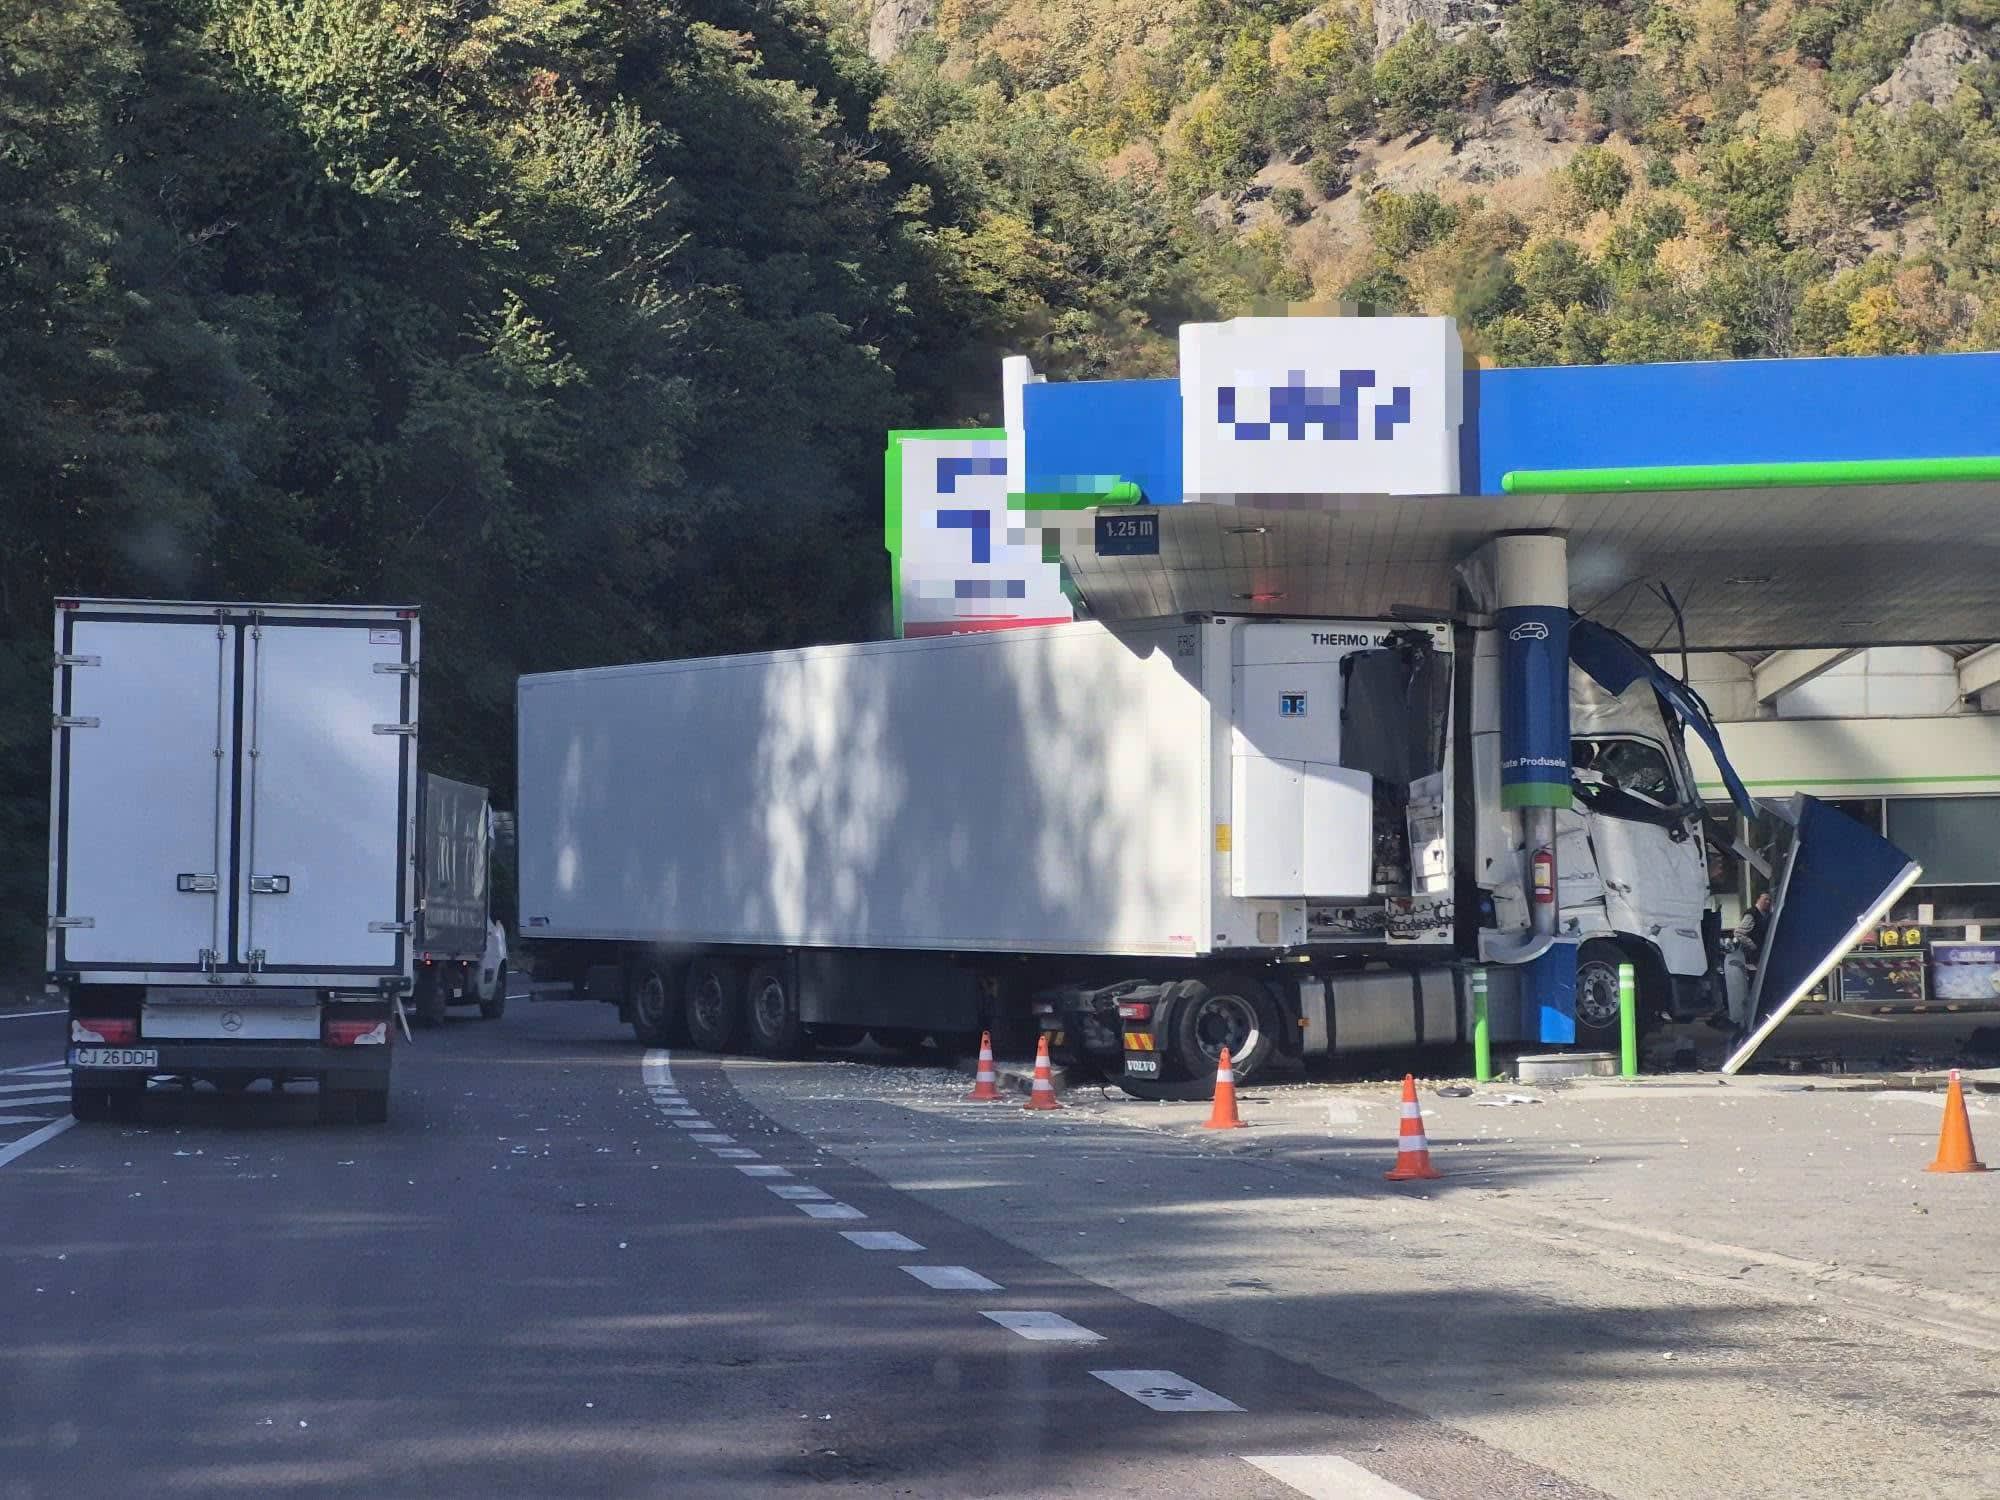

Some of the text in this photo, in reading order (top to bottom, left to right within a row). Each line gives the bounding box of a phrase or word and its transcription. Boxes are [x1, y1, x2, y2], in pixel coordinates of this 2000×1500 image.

[1140, 520, 1153, 536] m
[1311, 633, 1369, 646] THERMO
[79, 1049, 156, 1065] CJ 26 DDH
[1127, 1060, 1157, 1071] VOLVO
